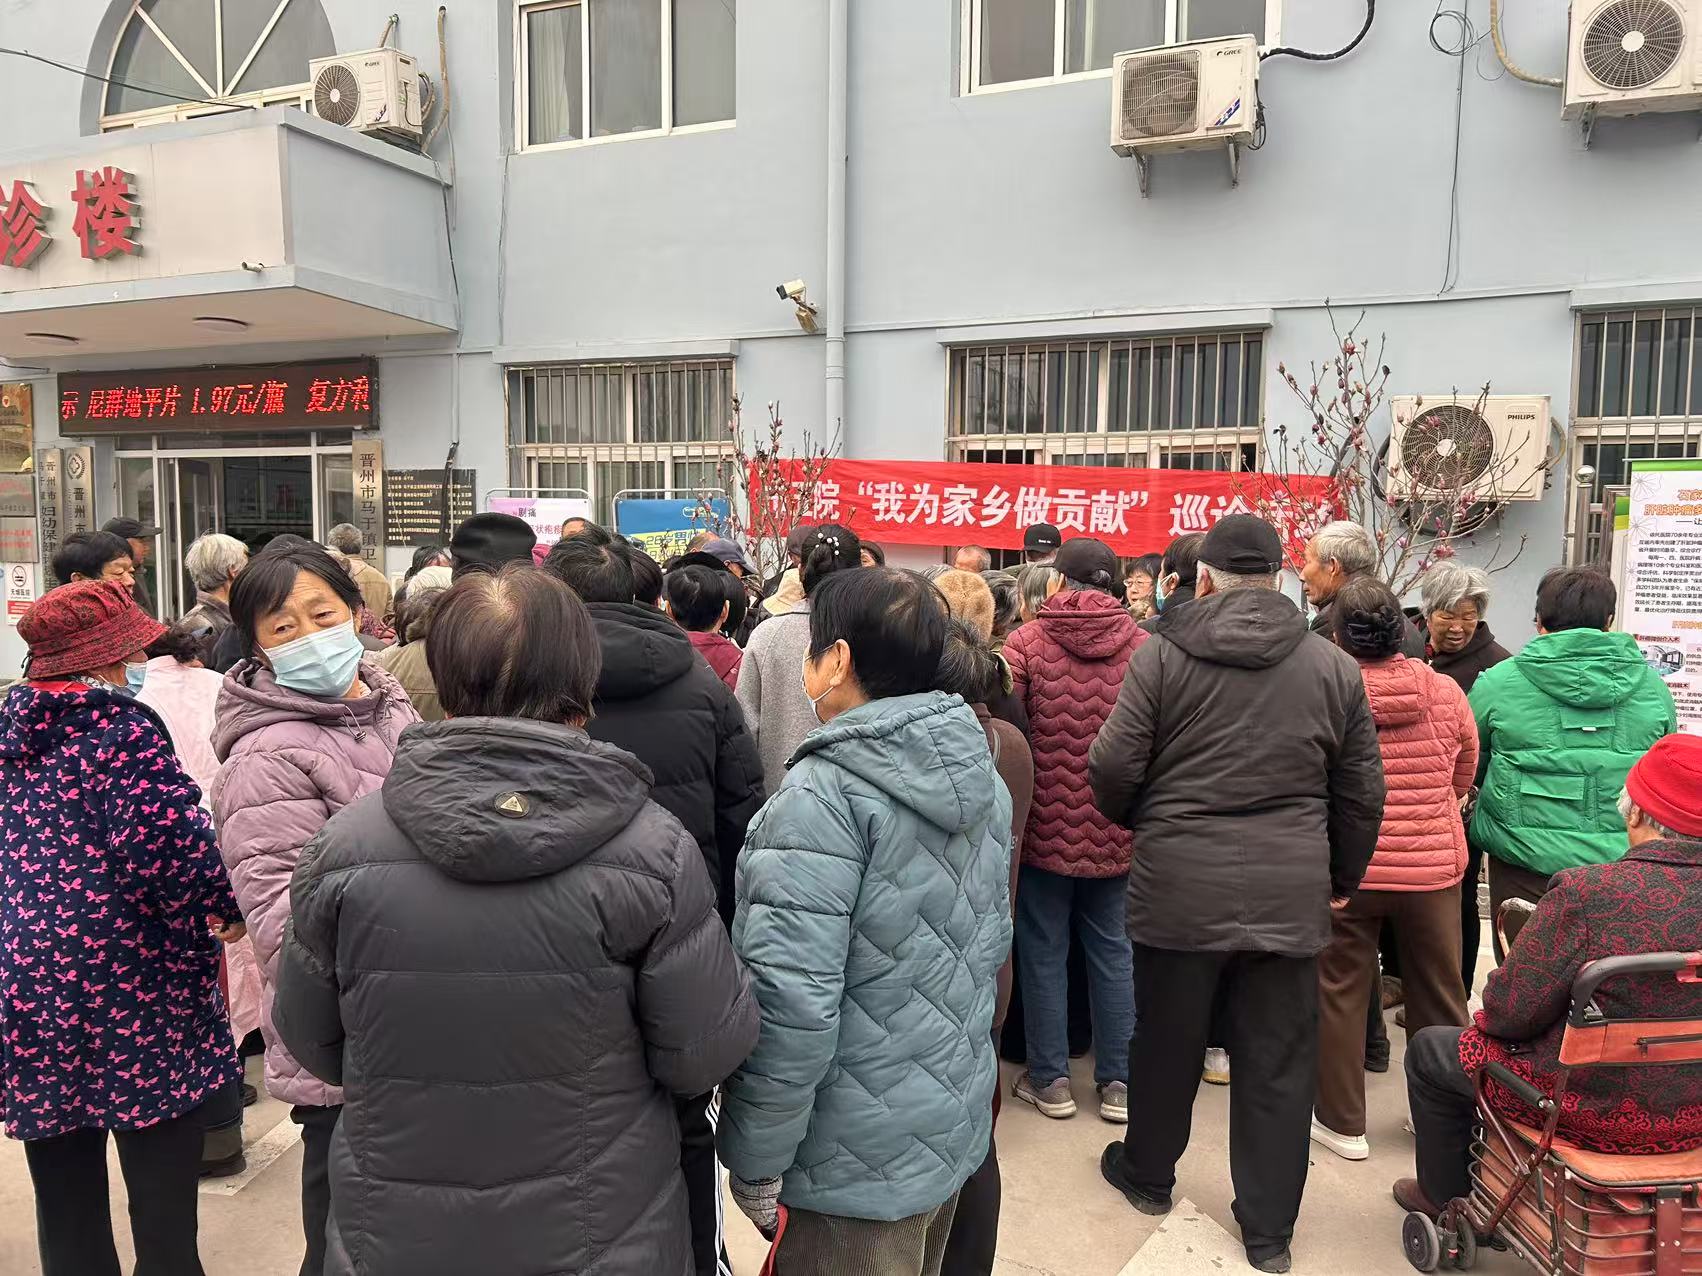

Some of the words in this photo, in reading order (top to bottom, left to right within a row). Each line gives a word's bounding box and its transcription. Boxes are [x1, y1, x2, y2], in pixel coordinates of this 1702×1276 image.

[0, 166, 142, 269] 诊楼
[73, 487, 86, 535] 晋州市
[360, 453, 377, 568] 晋州市马于镇卫
[857, 480, 1149, 536] “我为家乡做贡献”
